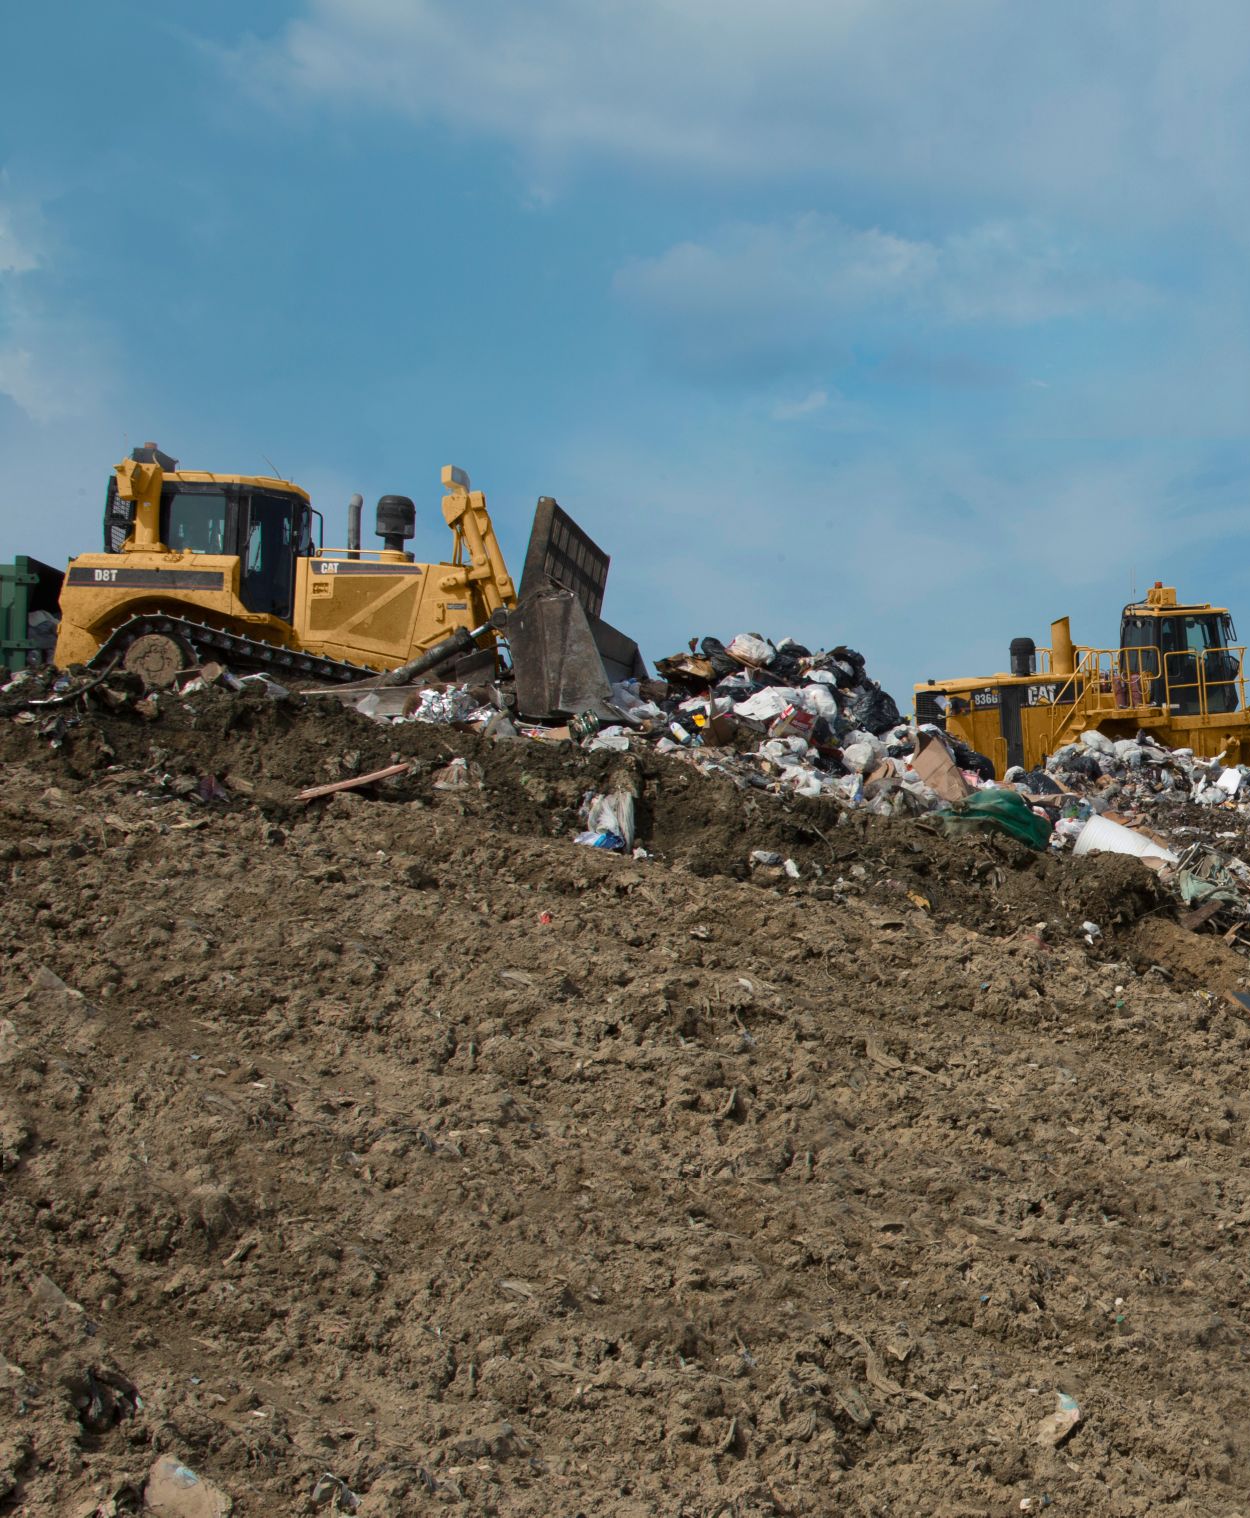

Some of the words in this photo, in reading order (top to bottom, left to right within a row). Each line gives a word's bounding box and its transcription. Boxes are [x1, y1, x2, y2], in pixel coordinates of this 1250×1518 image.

[321, 562, 340, 574] CAT
[94, 569, 118, 582] D8T
[1027, 684, 1057, 706] CAT
